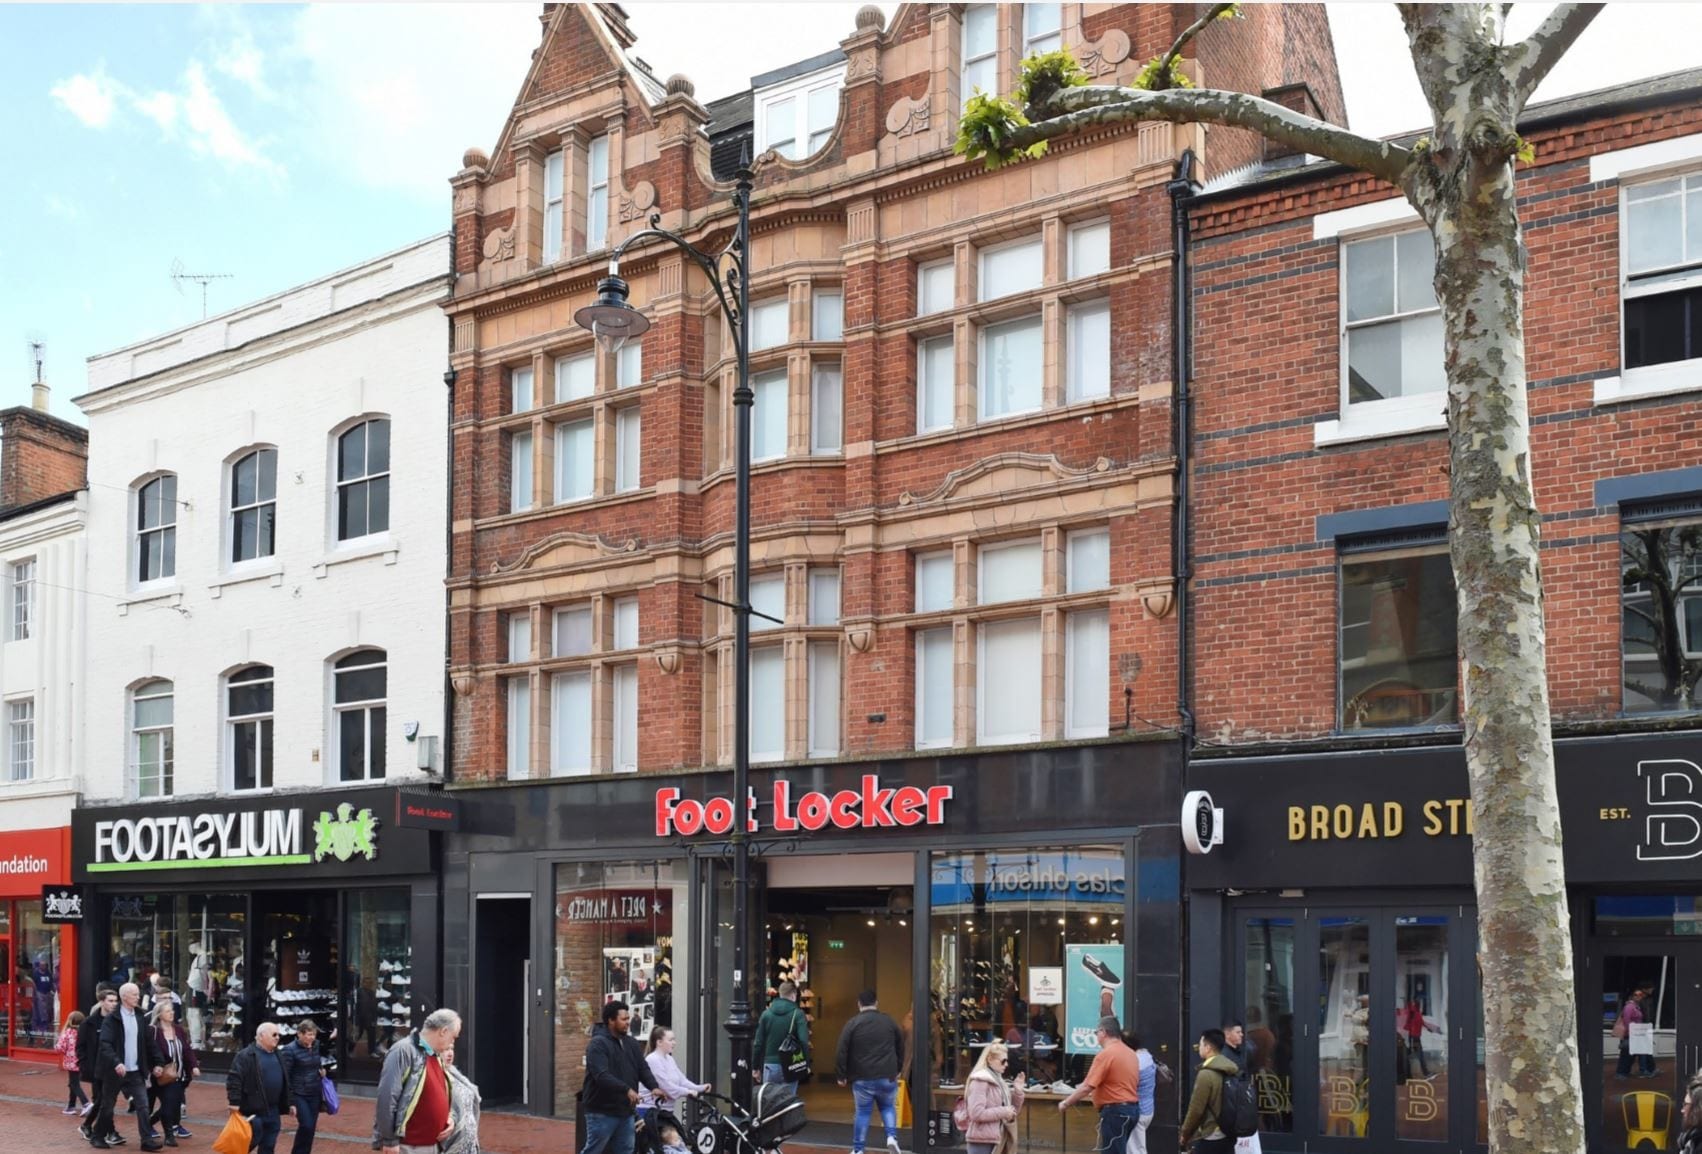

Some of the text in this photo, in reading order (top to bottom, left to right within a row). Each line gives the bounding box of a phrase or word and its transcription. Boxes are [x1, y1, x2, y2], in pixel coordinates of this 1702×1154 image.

[774, 775, 953, 831] Locker
[1288, 802, 1403, 841] BROAD
[1600, 808, 1631, 820] EST.
[95, 808, 303, 863] FOOTASYLUM
